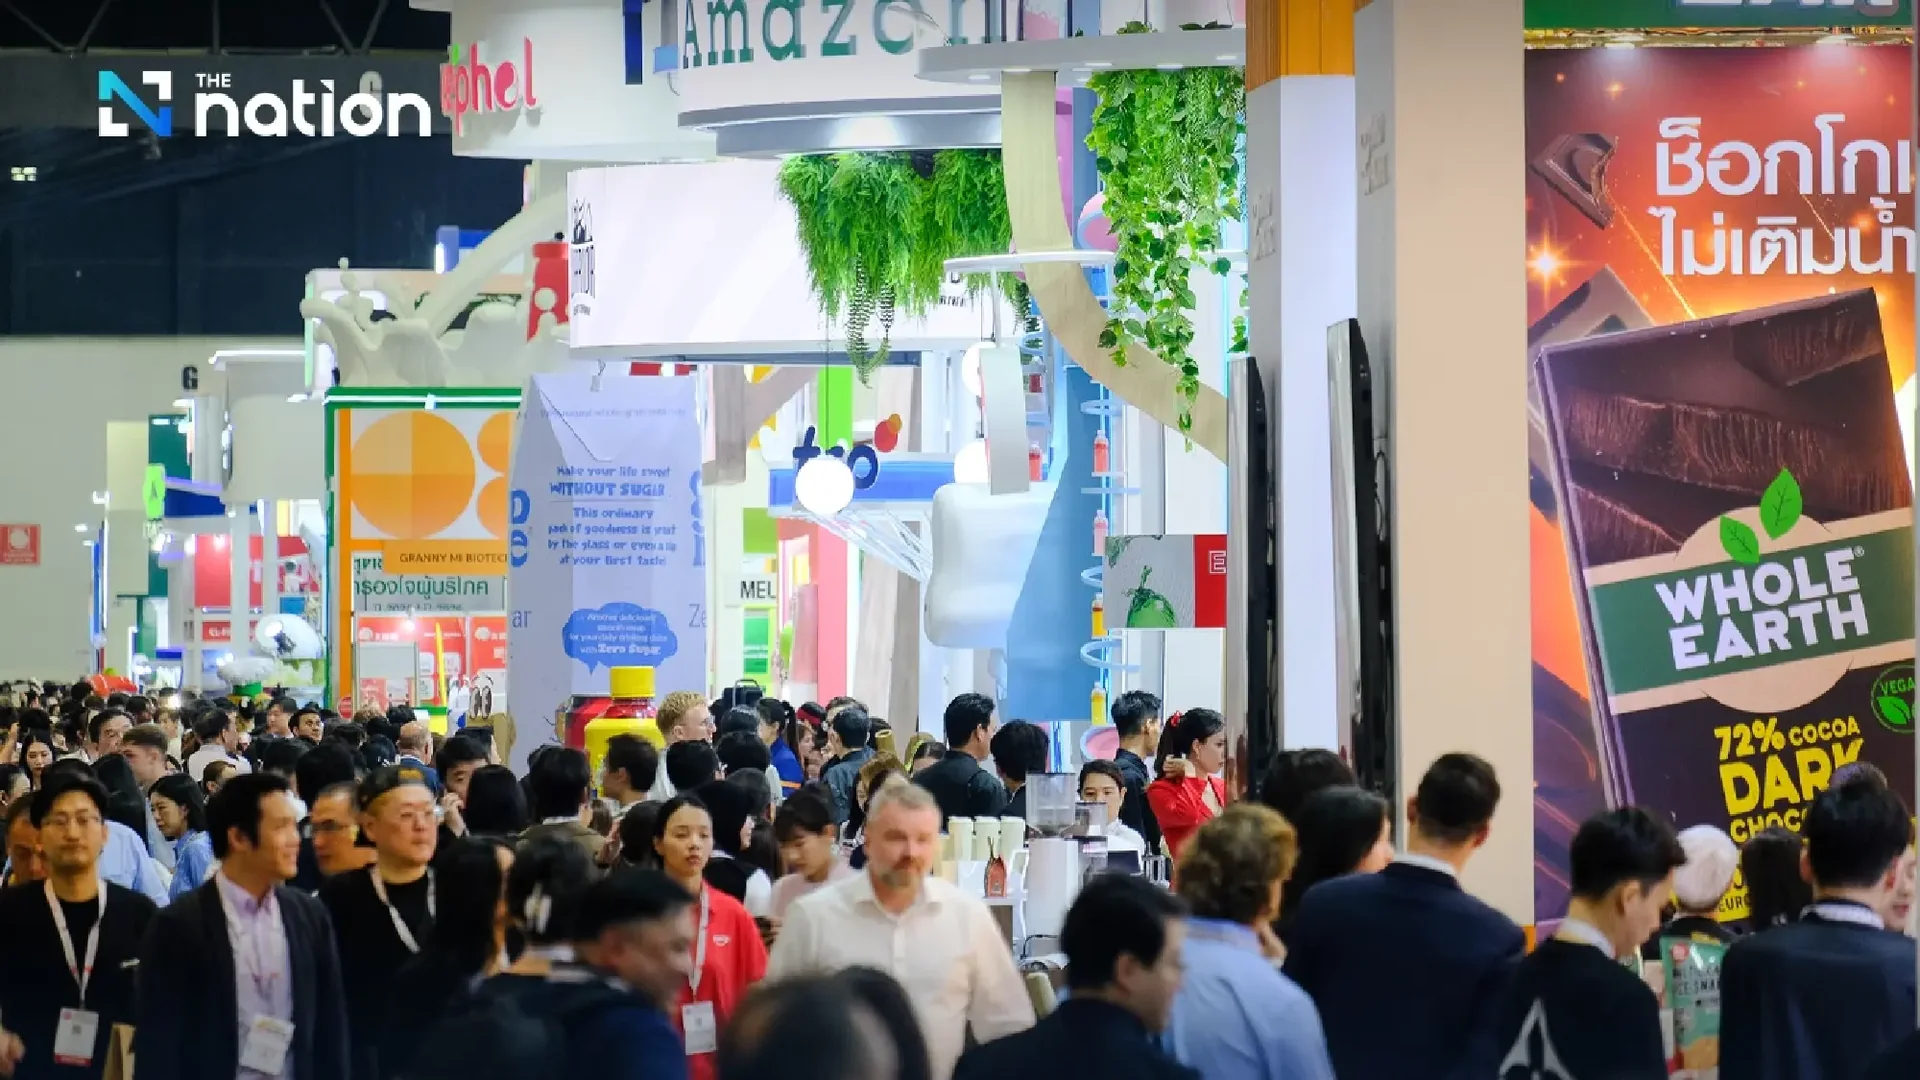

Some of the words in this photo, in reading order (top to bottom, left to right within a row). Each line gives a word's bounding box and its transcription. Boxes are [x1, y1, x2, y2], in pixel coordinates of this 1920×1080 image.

[183, 366, 198, 390] G
[587, 467, 616, 477] your
[620, 466, 638, 476] life
[550, 482, 616, 496] WITHOUT
[620, 483, 665, 496] SUGAR
[573, 507, 598, 518] This
[602, 507, 655, 519] ordinary
[584, 523, 638, 535] goodness
[613, 541, 626, 550] or
[399, 553, 447, 563] GRANNY
[573, 555, 601, 566] your
[1669, 592, 1869, 670] EARTH
[598, 643, 626, 654] Zero
[1714, 716, 1786, 761] 72%
[1788, 715, 1861, 746] COCOA
